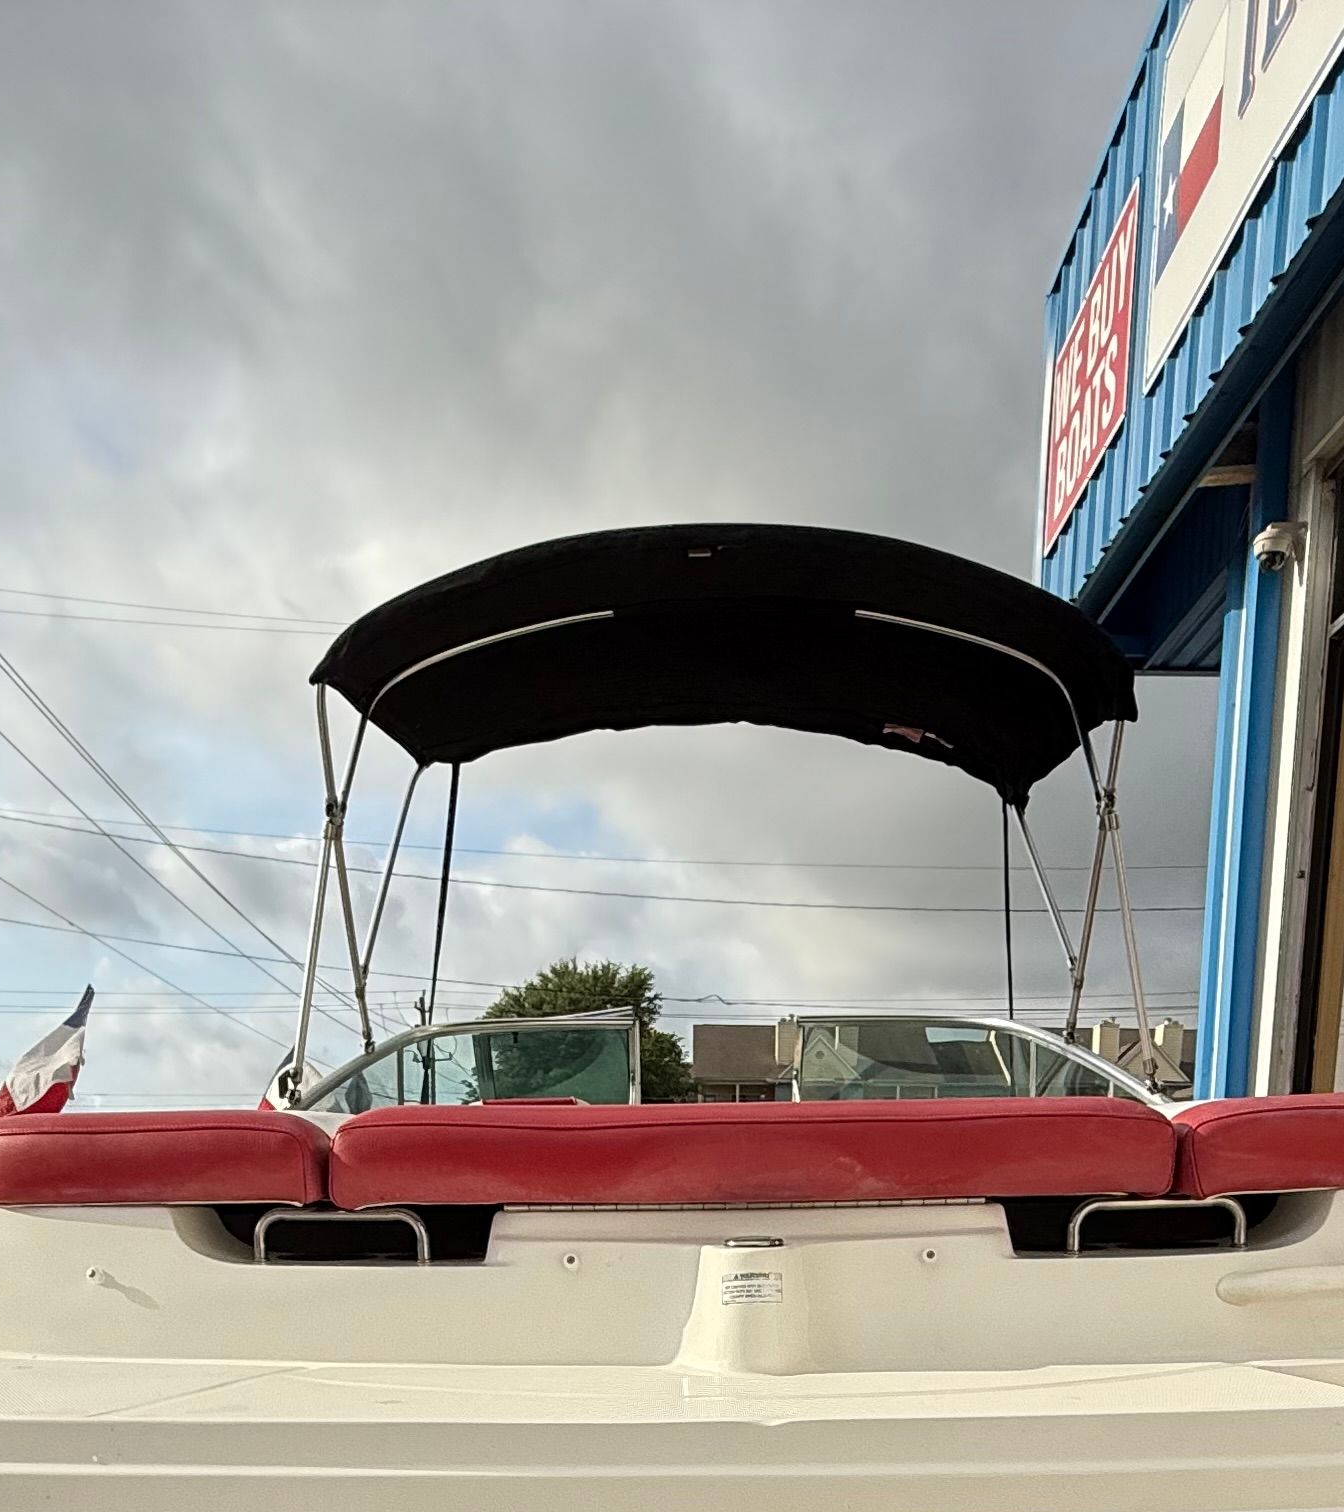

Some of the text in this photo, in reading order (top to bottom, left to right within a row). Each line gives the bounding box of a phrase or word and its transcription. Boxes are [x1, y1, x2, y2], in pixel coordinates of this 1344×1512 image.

[1054, 334, 1118, 521] BOATS
[1055, 205, 1136, 445] WE BUY
